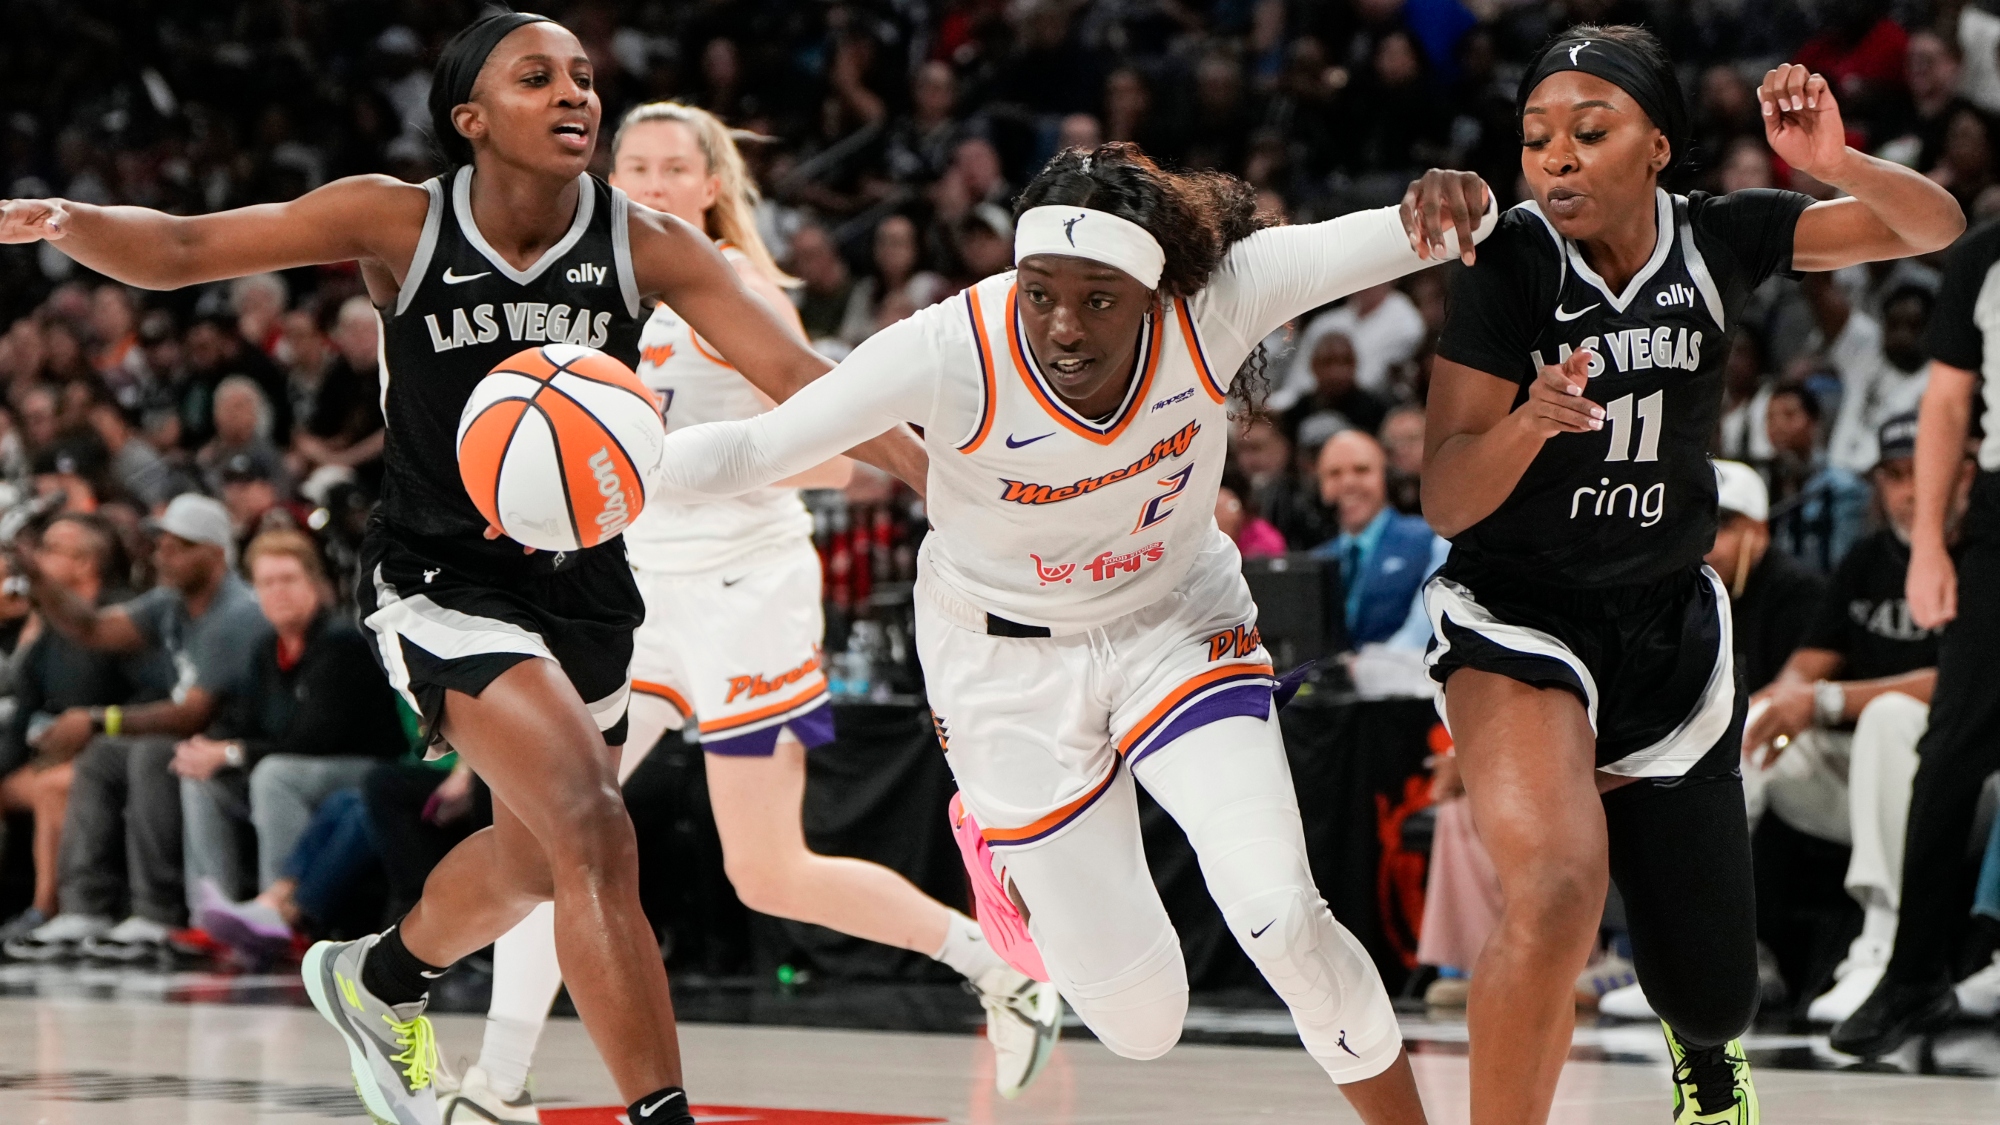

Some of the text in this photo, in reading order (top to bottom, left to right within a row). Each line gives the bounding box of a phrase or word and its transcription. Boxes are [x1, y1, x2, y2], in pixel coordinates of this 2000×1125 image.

[566, 262, 607, 286] ally
[1656, 283, 1695, 308] ally
[424, 302, 612, 353] LAS VEGAS
[1603, 325, 1703, 373] VEGAS
[1604, 389, 1664, 463] 11
[998, 418, 1202, 505] Mercury
[1130, 459, 1195, 536] 2
[1569, 477, 1665, 528] ring
